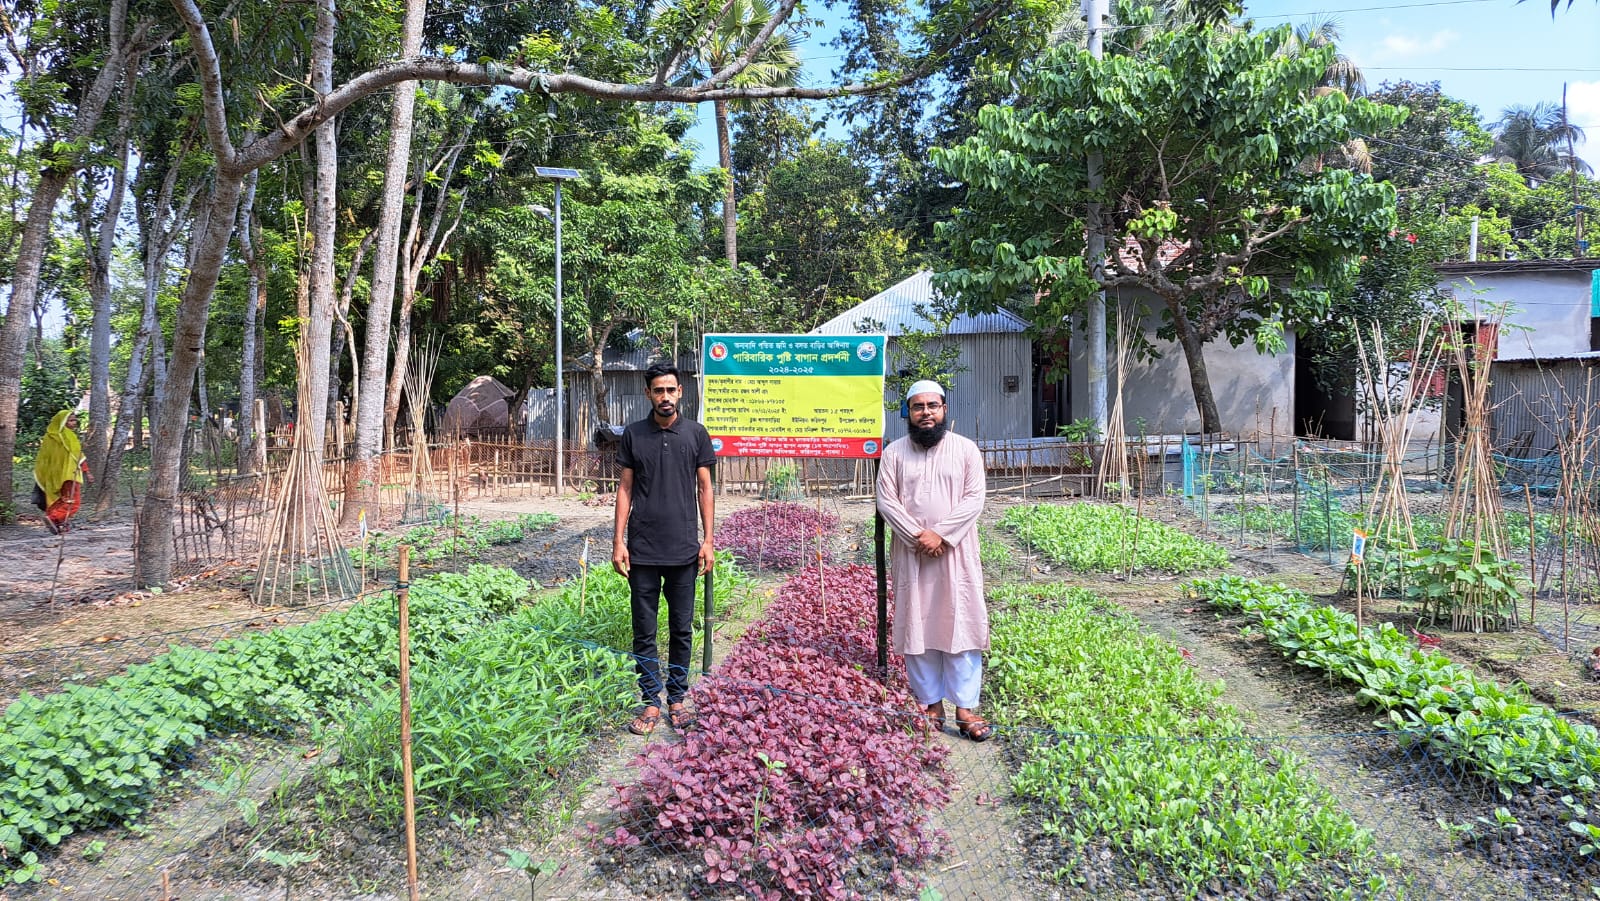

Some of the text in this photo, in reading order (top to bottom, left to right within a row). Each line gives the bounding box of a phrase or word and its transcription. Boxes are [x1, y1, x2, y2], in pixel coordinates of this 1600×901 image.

[758, 341, 774, 349] পতিত
[776, 341, 786, 349] জমি
[810, 340, 825, 350] বাড়ির
[733, 351, 773, 362] পারিবারিক
[777, 351, 792, 364] পুষ্টি
[794, 353, 818, 362] বাগান
[821, 351, 850, 363] প্রদর্শনী
